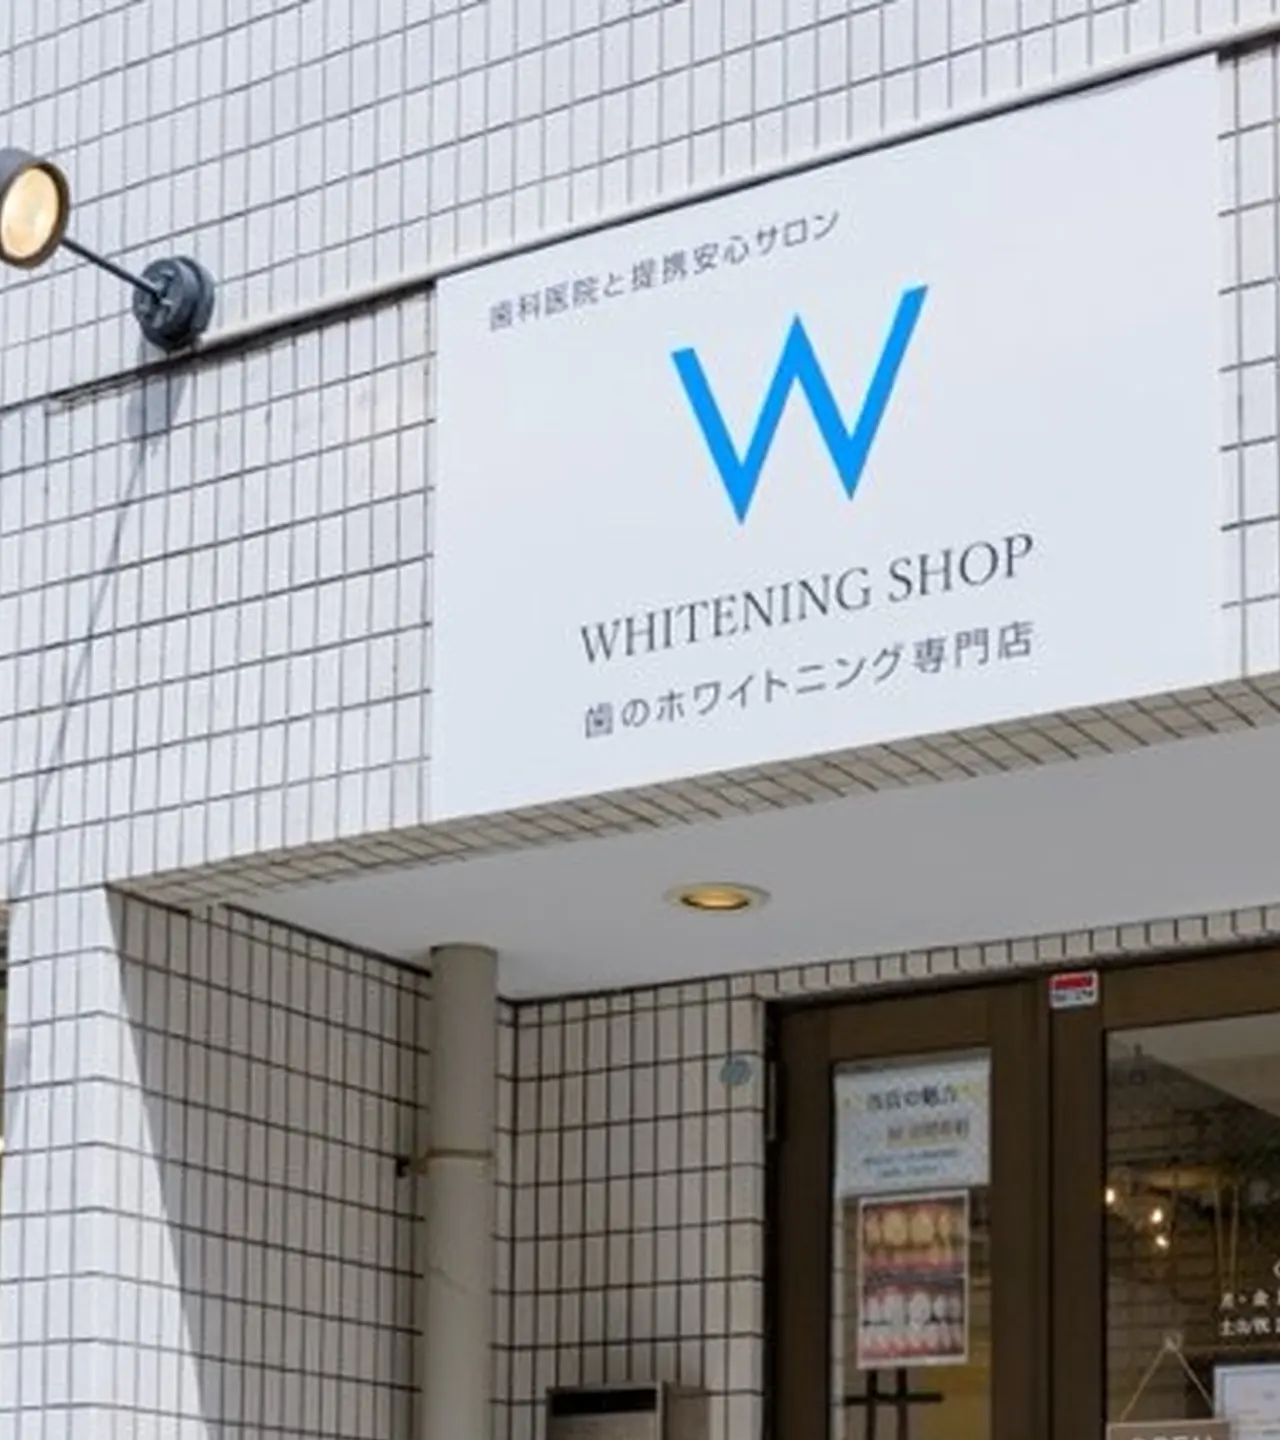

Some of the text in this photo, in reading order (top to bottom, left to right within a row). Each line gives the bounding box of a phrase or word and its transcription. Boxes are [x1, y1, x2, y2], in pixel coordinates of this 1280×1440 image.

[489, 211, 840, 332] 歯科医院と提携安心サロン
[670, 283, 928, 524] W
[579, 532, 1034, 664] WHITENING SHOP
[584, 619, 1034, 739] 歯のホワイトニング専門店
